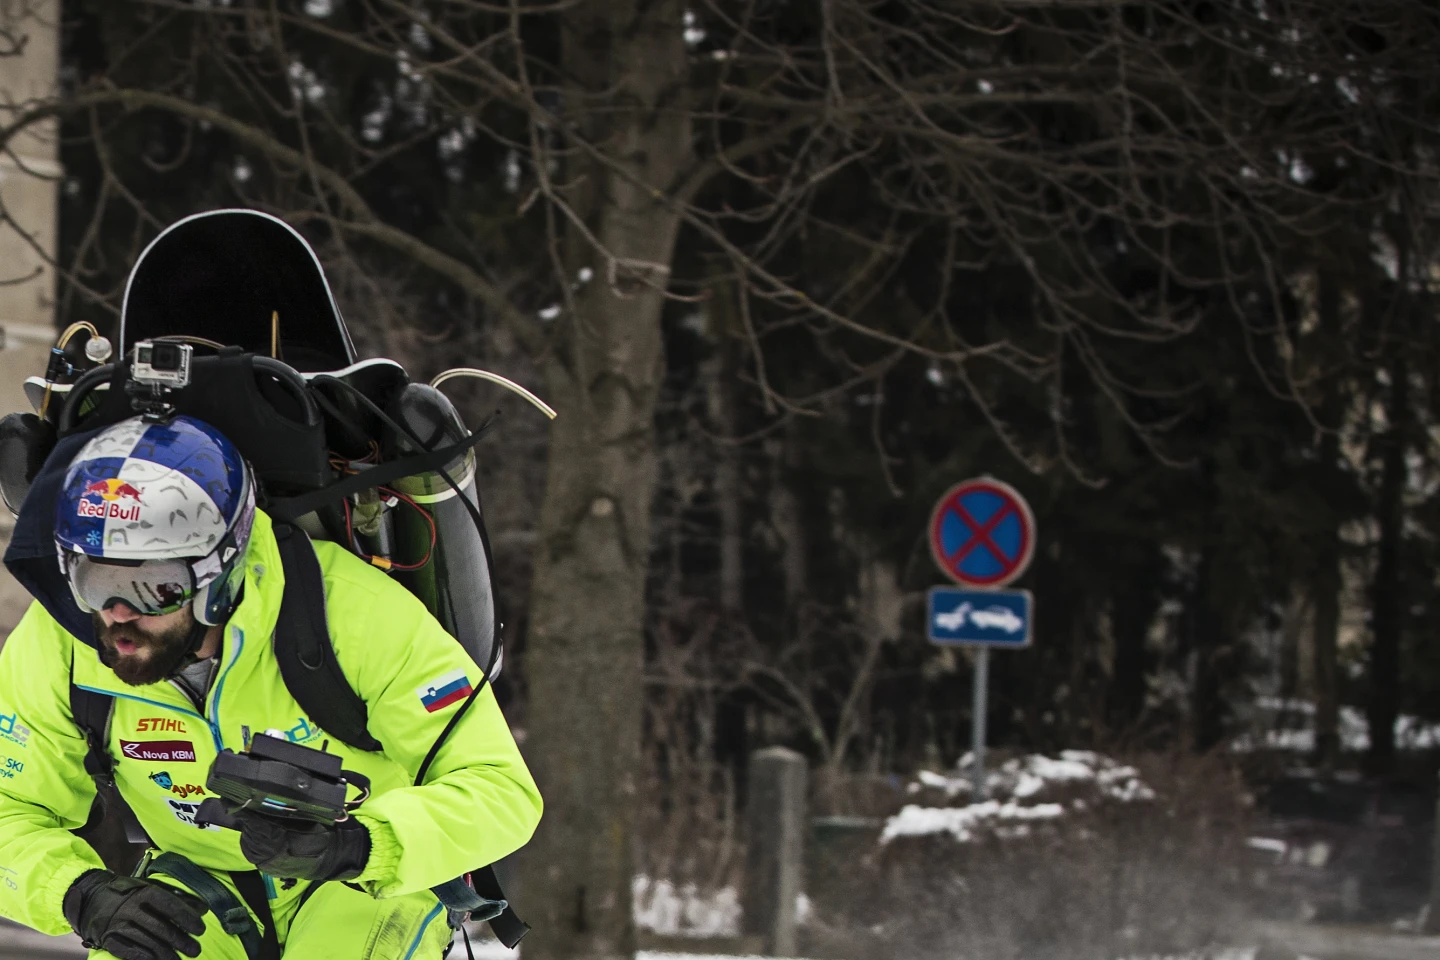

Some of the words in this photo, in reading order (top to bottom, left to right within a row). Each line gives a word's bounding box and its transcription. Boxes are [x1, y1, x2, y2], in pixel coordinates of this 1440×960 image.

[78, 500, 106, 516] Red
[109, 503, 140, 521] Bull
[136, 718, 186, 733] STIHL
[142, 750, 170, 760] Nova
[171, 750, 195, 760] KBM
